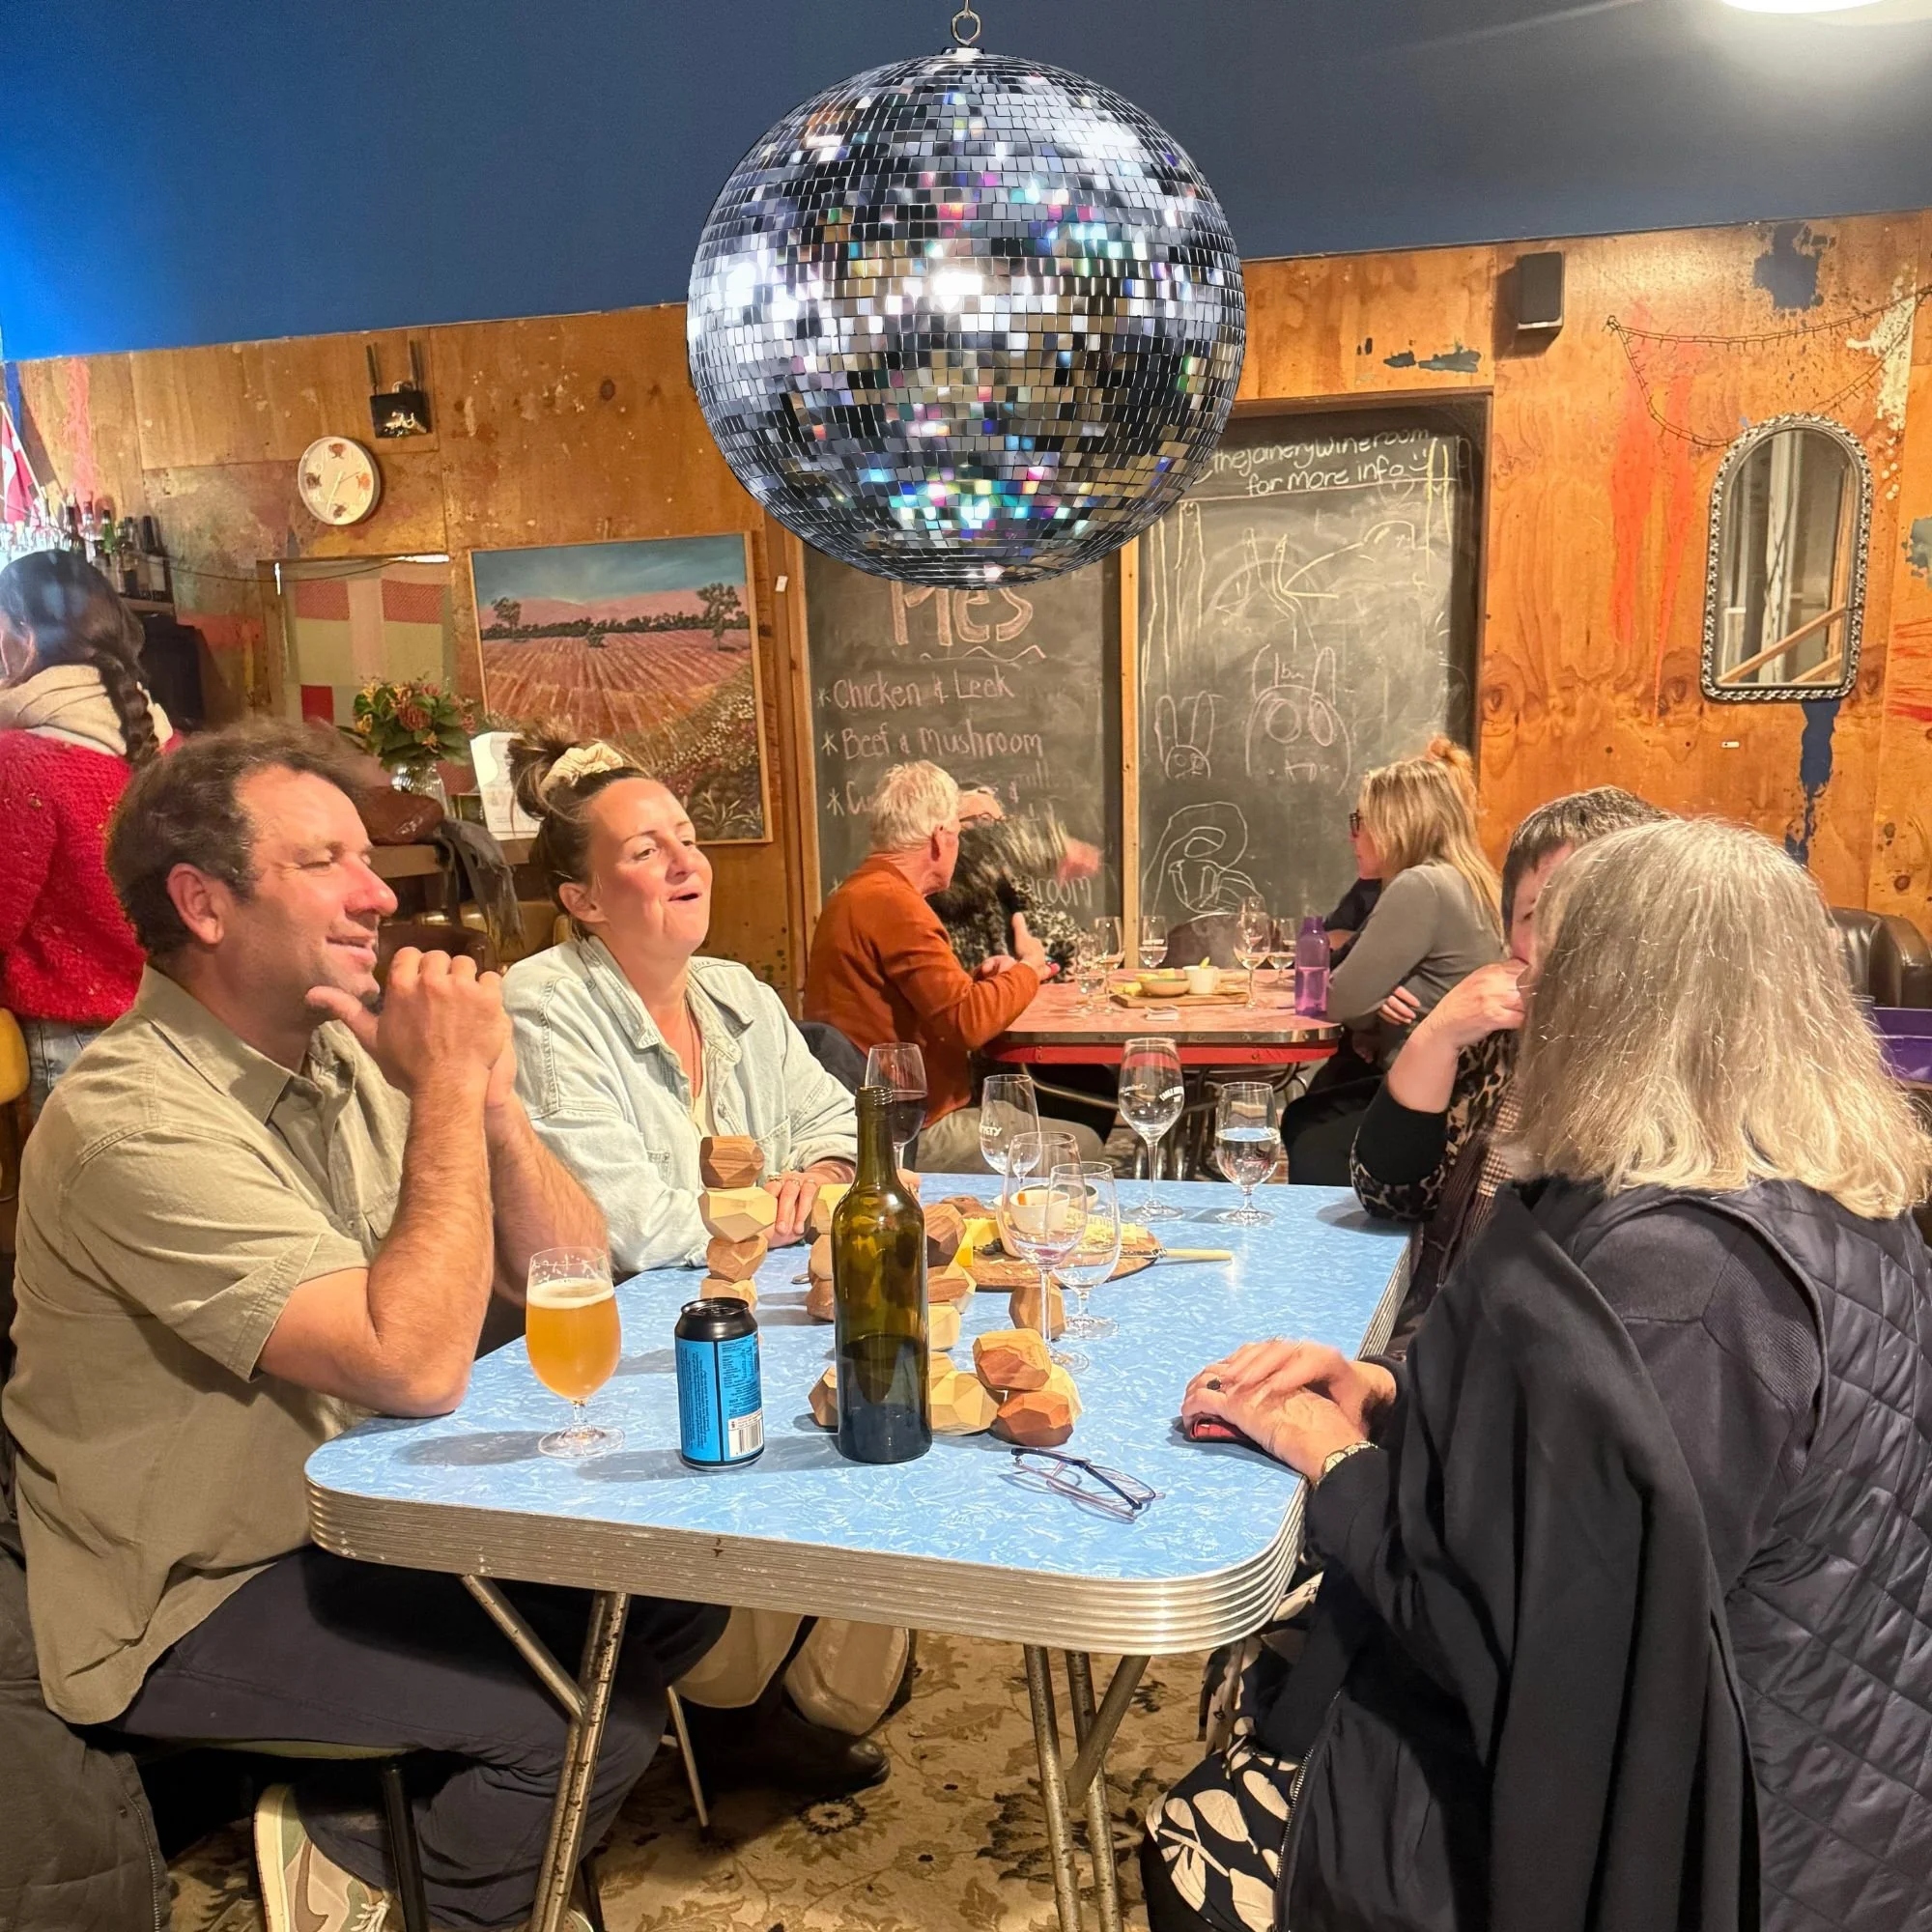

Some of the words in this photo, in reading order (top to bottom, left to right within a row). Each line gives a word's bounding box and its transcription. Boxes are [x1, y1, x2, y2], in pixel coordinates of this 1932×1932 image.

[1245, 472, 1283, 497] for
[1357, 454, 1405, 485] info
[833, 670, 922, 711] Chicken
[953, 665, 1016, 699] Leek
[841, 723, 890, 761] Beef
